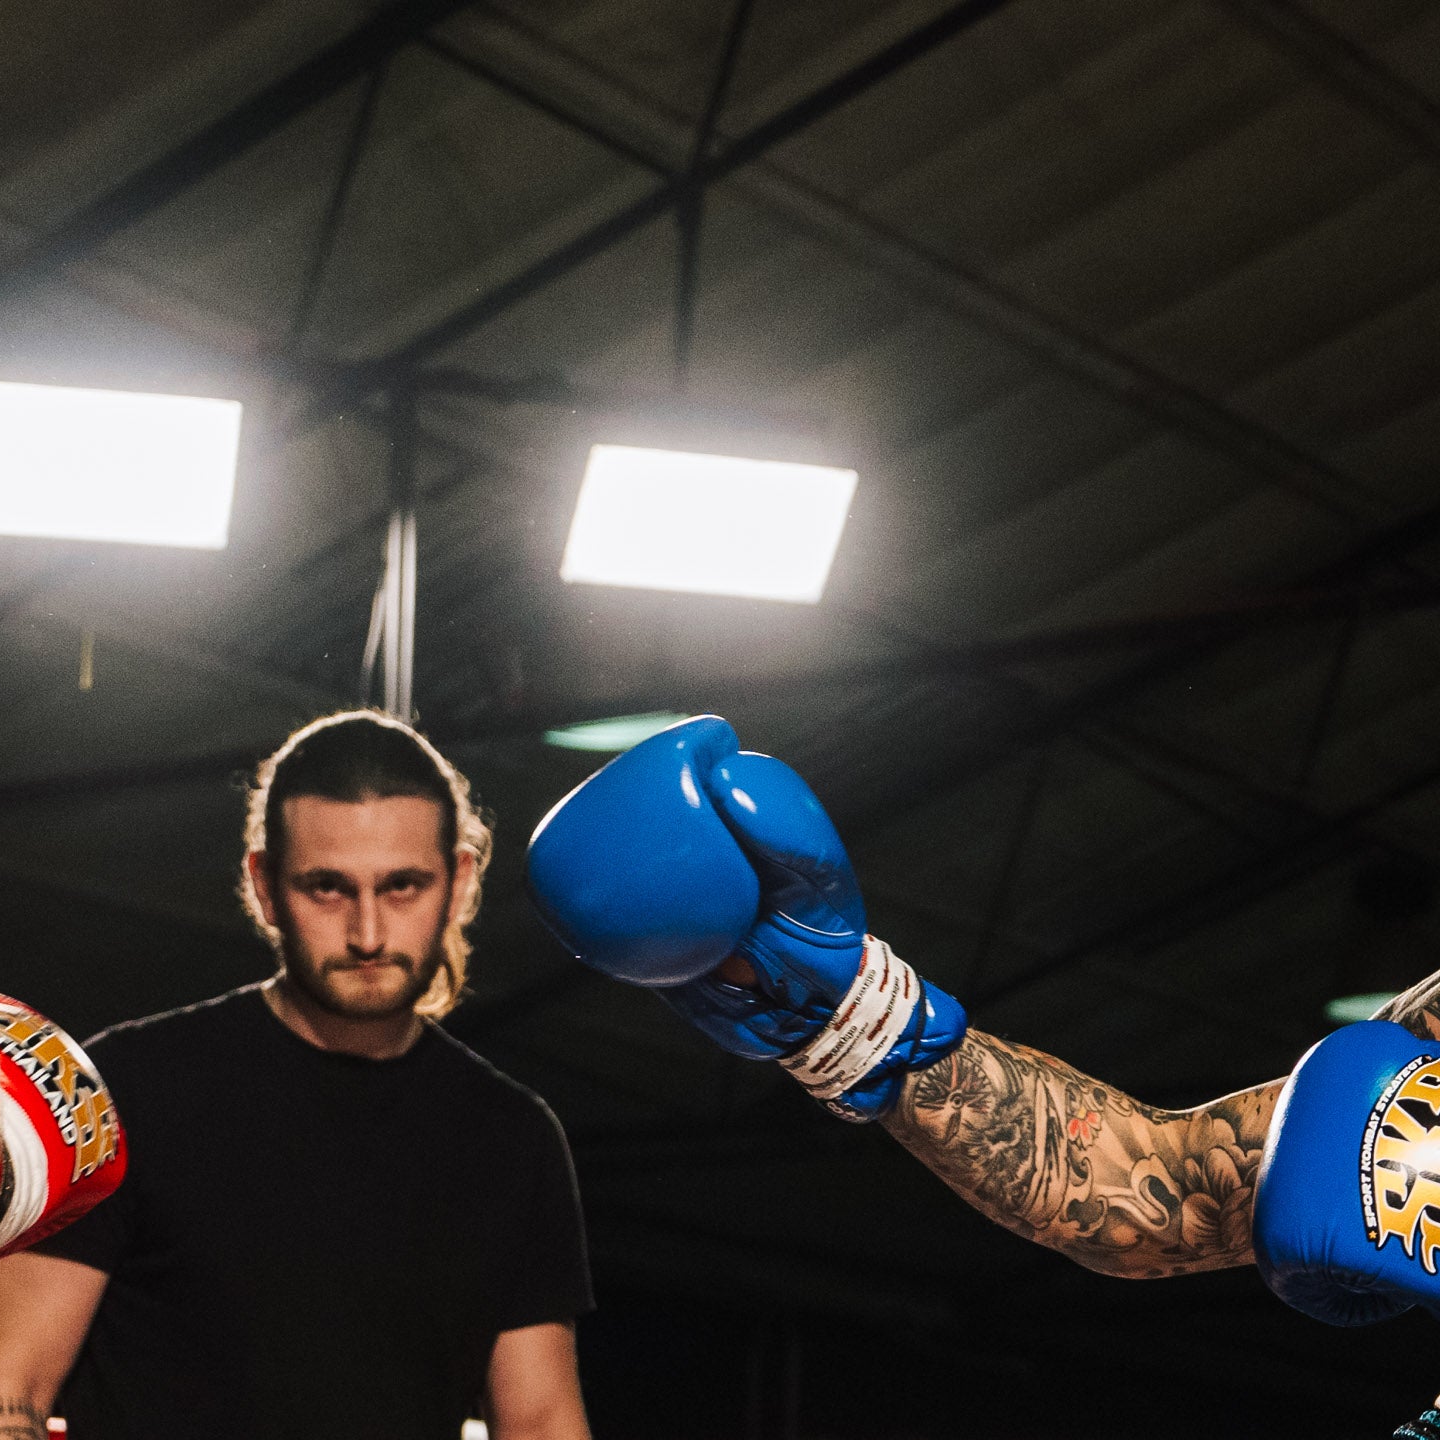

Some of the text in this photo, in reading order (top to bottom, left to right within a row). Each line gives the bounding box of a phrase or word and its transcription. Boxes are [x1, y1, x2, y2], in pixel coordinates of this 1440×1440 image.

[1361, 1056, 1423, 1228] SPORT KOMBAT STRATEGY
